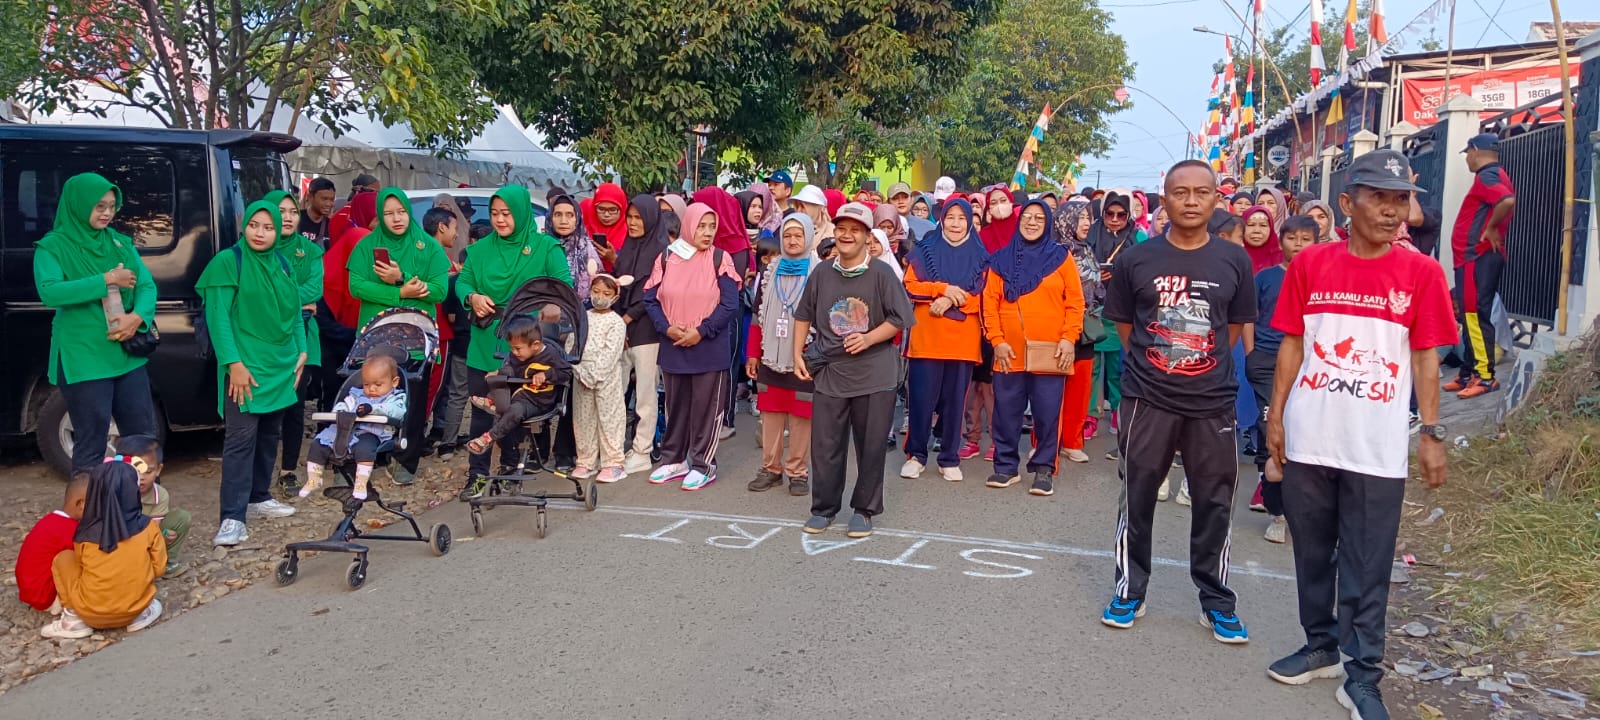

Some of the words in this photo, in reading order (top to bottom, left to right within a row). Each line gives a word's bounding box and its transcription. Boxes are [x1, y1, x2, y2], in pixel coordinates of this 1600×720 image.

[1481, 92, 1505, 103] 35GB
[1527, 89, 1551, 98] 18GB
[1413, 110, 1434, 119] Dak
[1310, 291, 1323, 301] KU
[1333, 291, 1361, 302] KAMU
[1362, 294, 1388, 306] SATU
[1296, 371, 1396, 403] NDONESIA
[618, 518, 1044, 578] START
